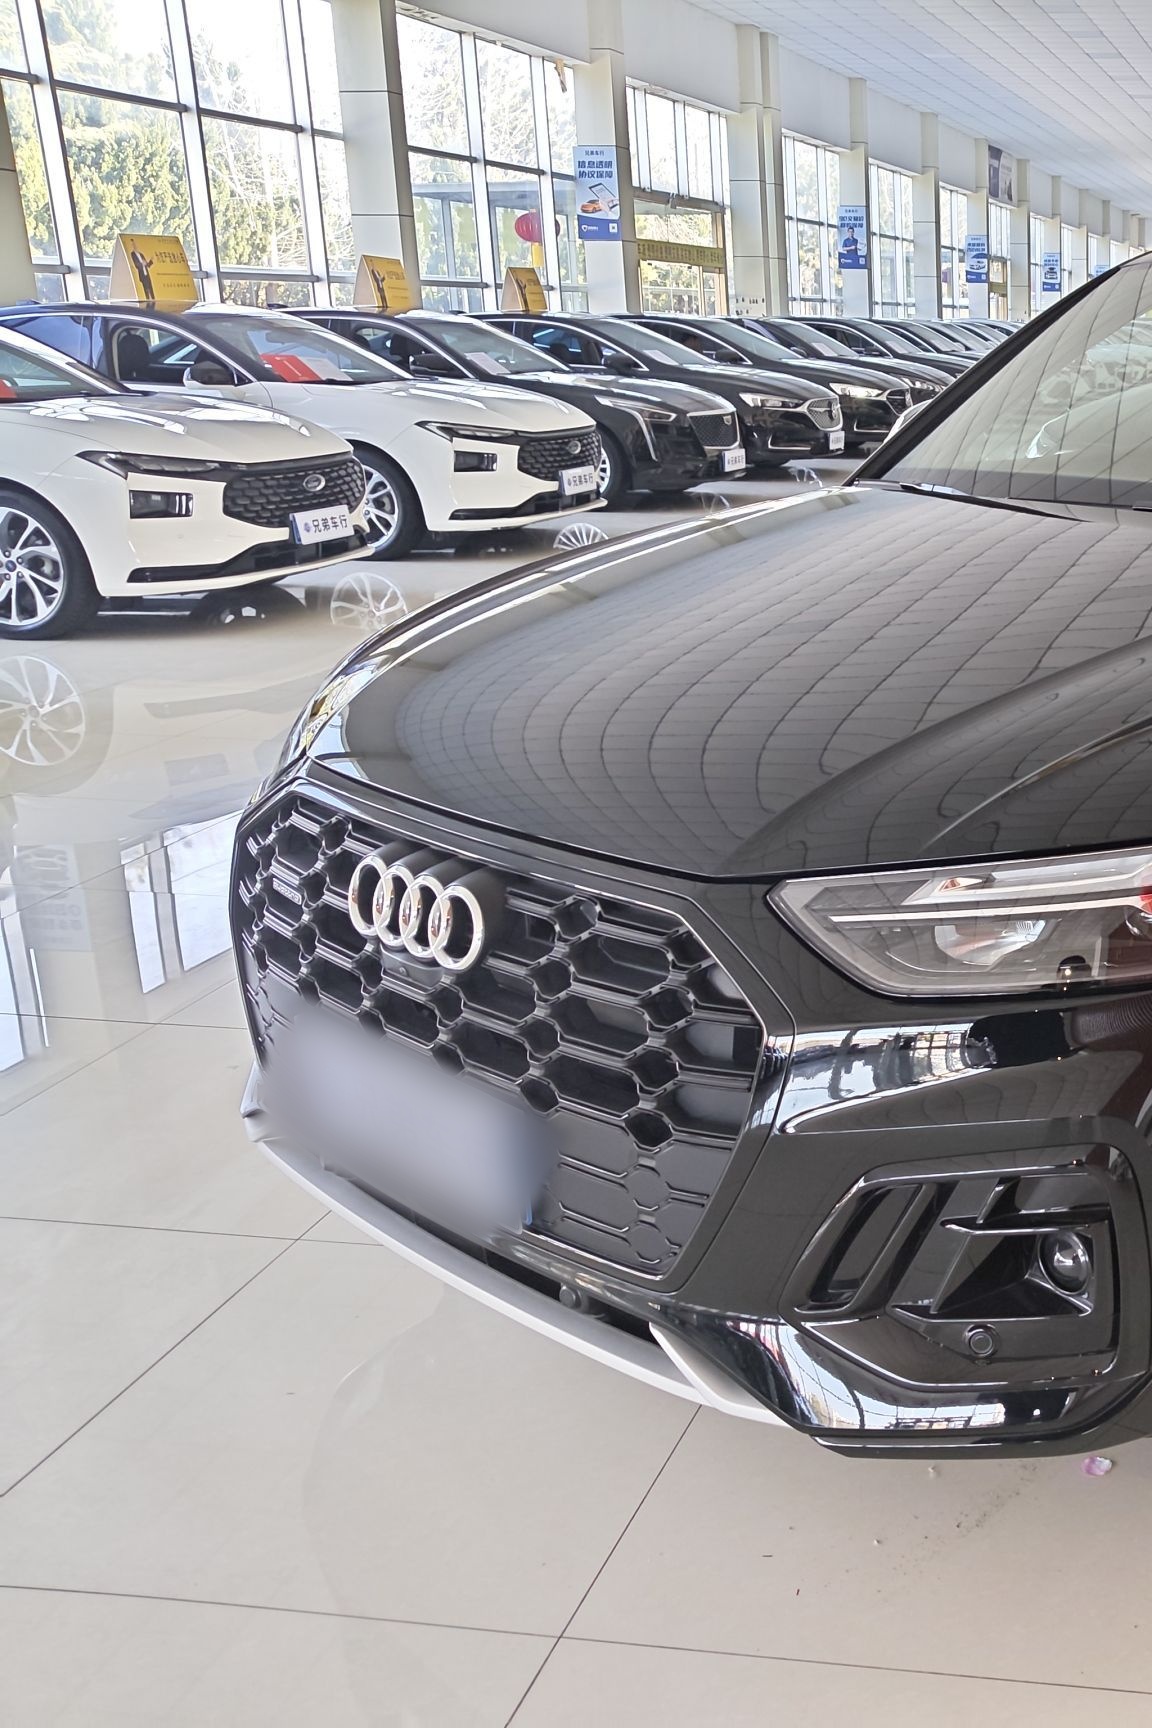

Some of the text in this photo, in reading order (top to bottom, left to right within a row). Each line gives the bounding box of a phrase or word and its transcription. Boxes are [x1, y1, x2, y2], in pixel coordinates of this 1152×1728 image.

[577, 160, 613, 169] 信息透明
[578, 170, 613, 179] 协议保障
[311, 514, 348, 534] 兄弟车行
